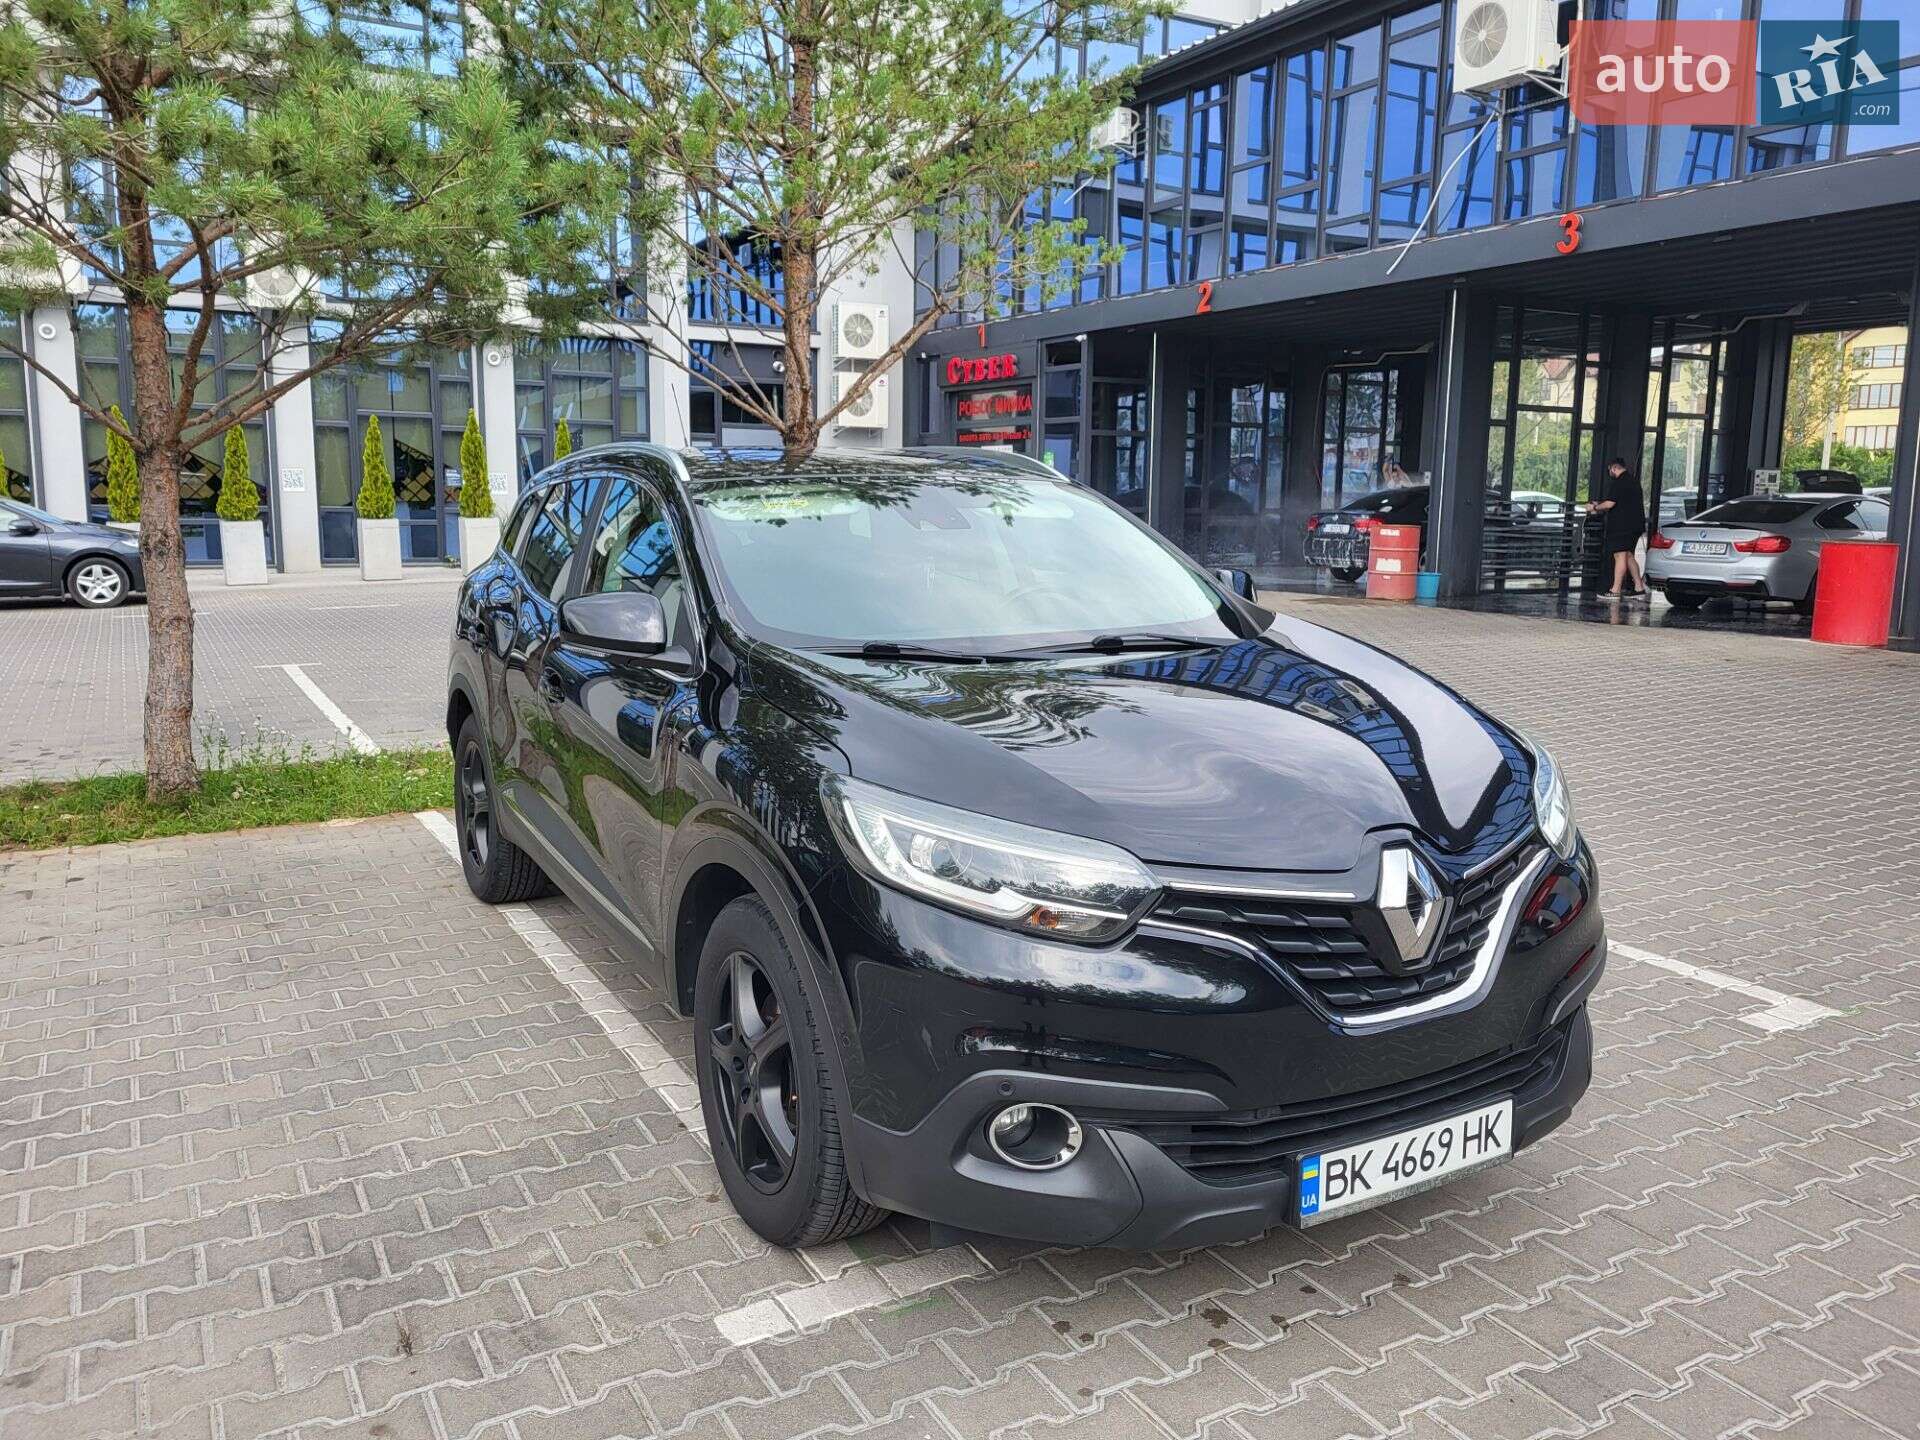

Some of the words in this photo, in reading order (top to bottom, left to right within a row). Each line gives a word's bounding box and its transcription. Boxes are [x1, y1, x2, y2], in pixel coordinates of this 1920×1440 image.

[1556, 213, 1580, 254] 3
[1197, 281, 1212, 313] 2
[977, 323, 987, 348] 1
[1325, 1149, 1374, 1202] BK
[1381, 1127, 1454, 1182] 4669
[1462, 1110, 1503, 1159] HK
[1302, 1194, 1317, 1208] UA
